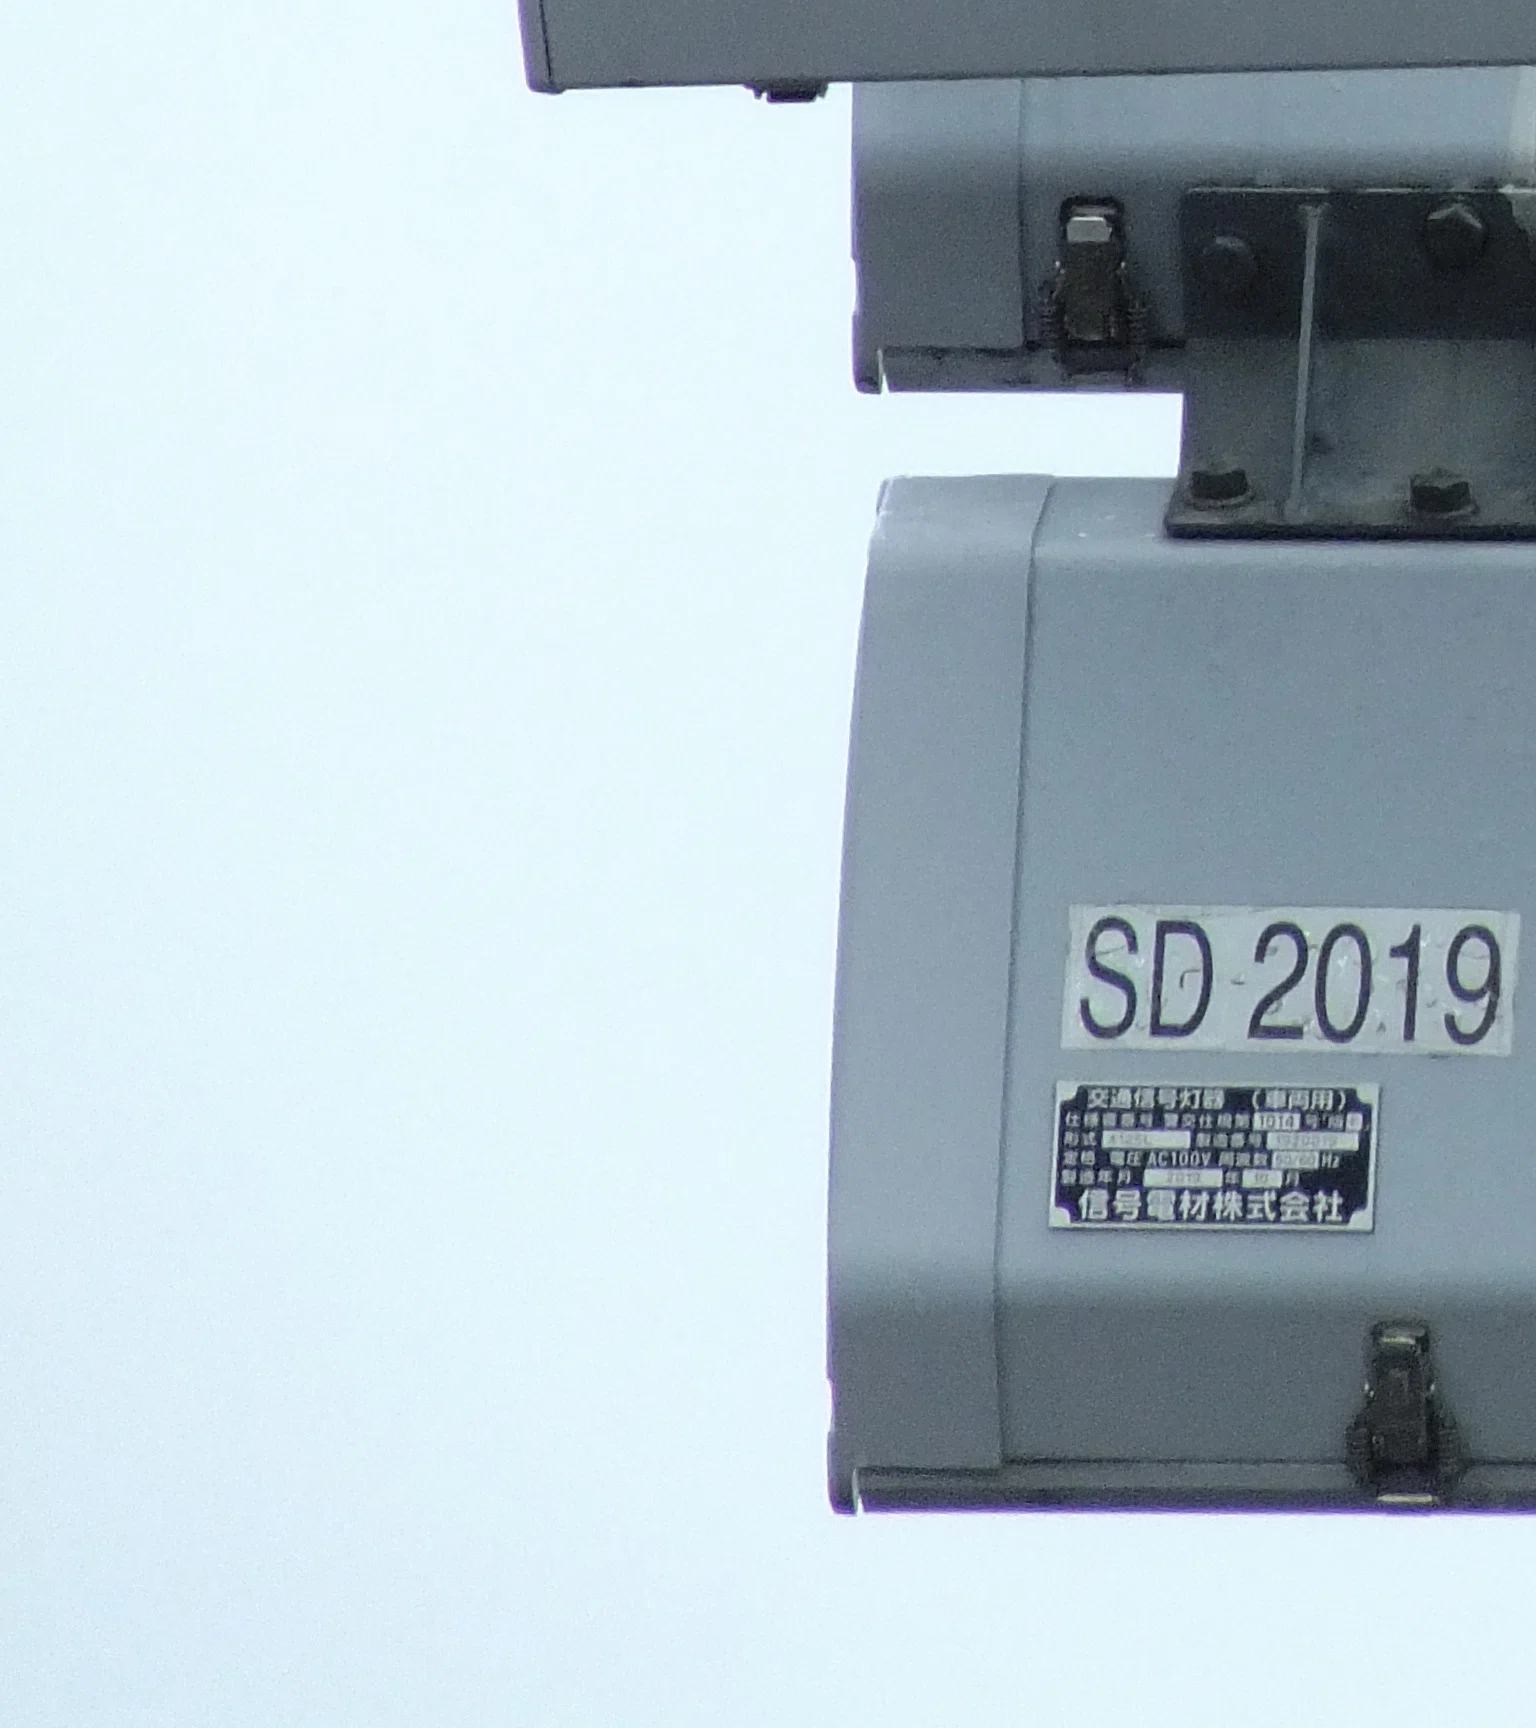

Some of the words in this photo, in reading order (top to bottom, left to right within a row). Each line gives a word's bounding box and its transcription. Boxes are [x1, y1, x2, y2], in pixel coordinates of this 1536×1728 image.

[1078, 914, 1214, 1041] SD
[1247, 920, 1504, 1046] 2019
[1078, 1189, 1344, 1222] 信号電材株式会社
